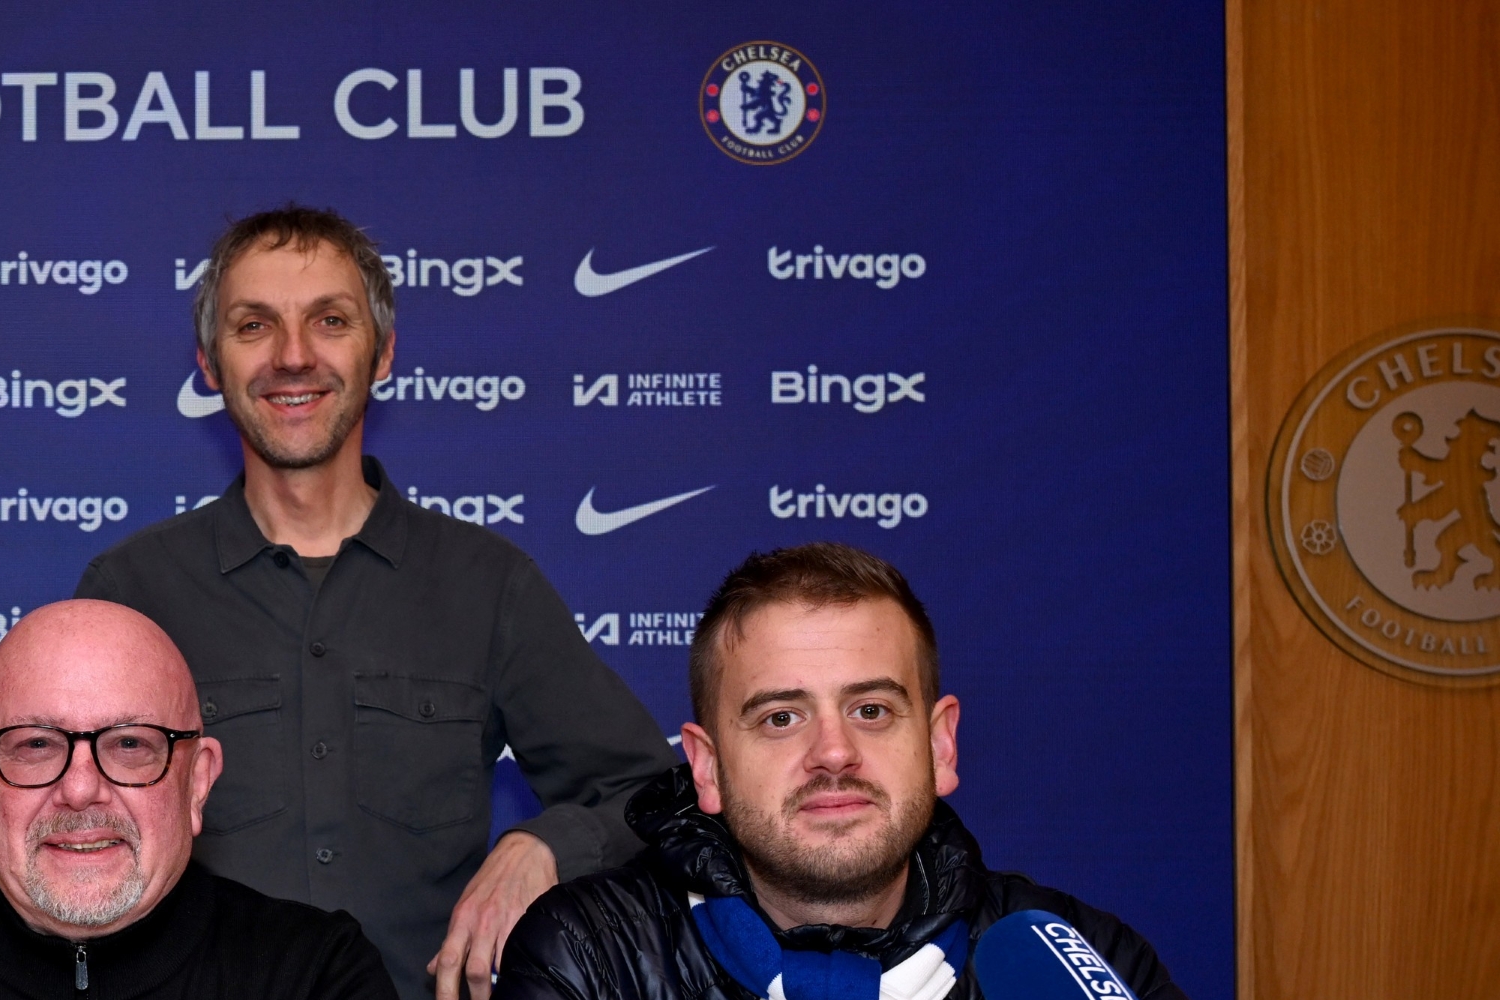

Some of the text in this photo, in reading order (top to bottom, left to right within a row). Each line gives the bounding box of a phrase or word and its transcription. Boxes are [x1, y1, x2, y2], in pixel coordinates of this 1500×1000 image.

[721, 45, 802, 72] CHELSEA
[334, 68, 584, 140] CLUB
[768, 245, 926, 289] trivago
[628, 373, 722, 389] INFINITE
[1347, 342, 1500, 409] CHELS
[627, 390, 722, 406] ATHLETE
[769, 484, 928, 529] trivago
[629, 613, 703, 629] INFINI
[628, 630, 694, 646] ATHLE
